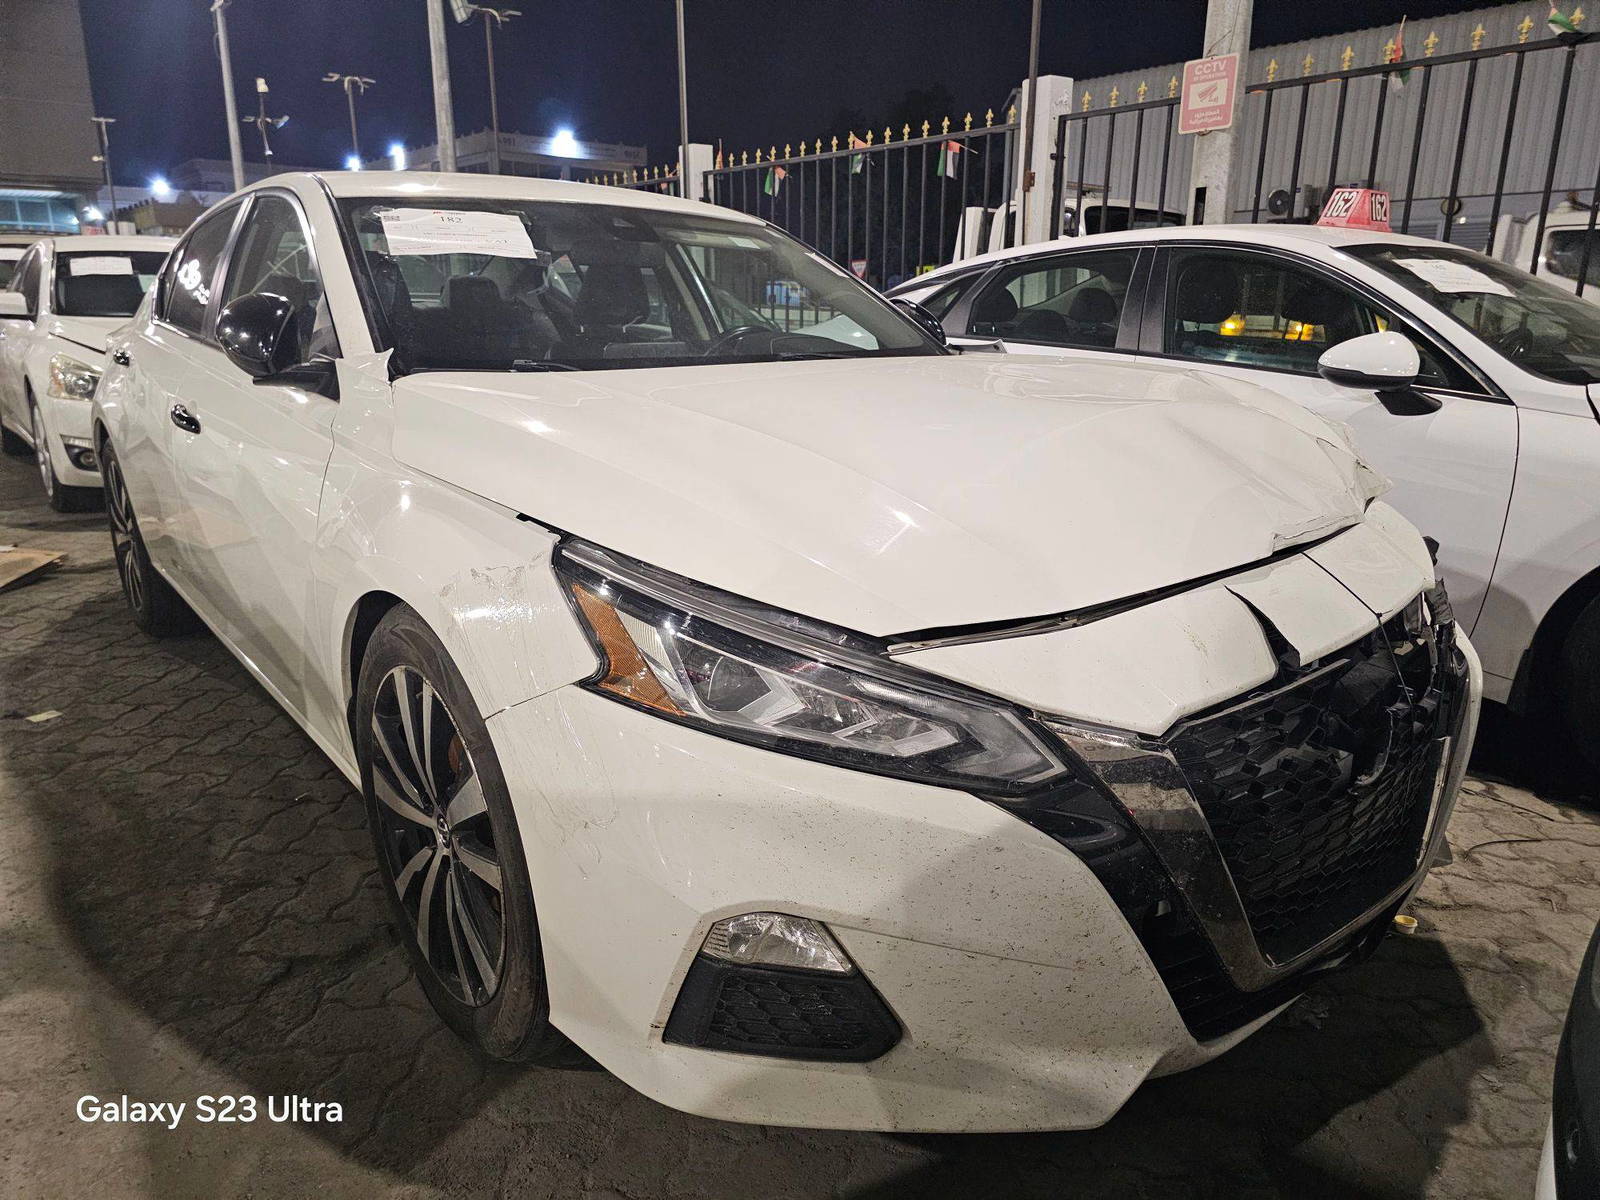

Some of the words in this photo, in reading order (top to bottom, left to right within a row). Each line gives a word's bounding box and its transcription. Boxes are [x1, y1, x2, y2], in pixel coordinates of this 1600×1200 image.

[1194, 60, 1226, 76] CCTV
[1326, 191, 1358, 217] 162
[1371, 193, 1387, 221] 162
[440, 215, 464, 224] 182
